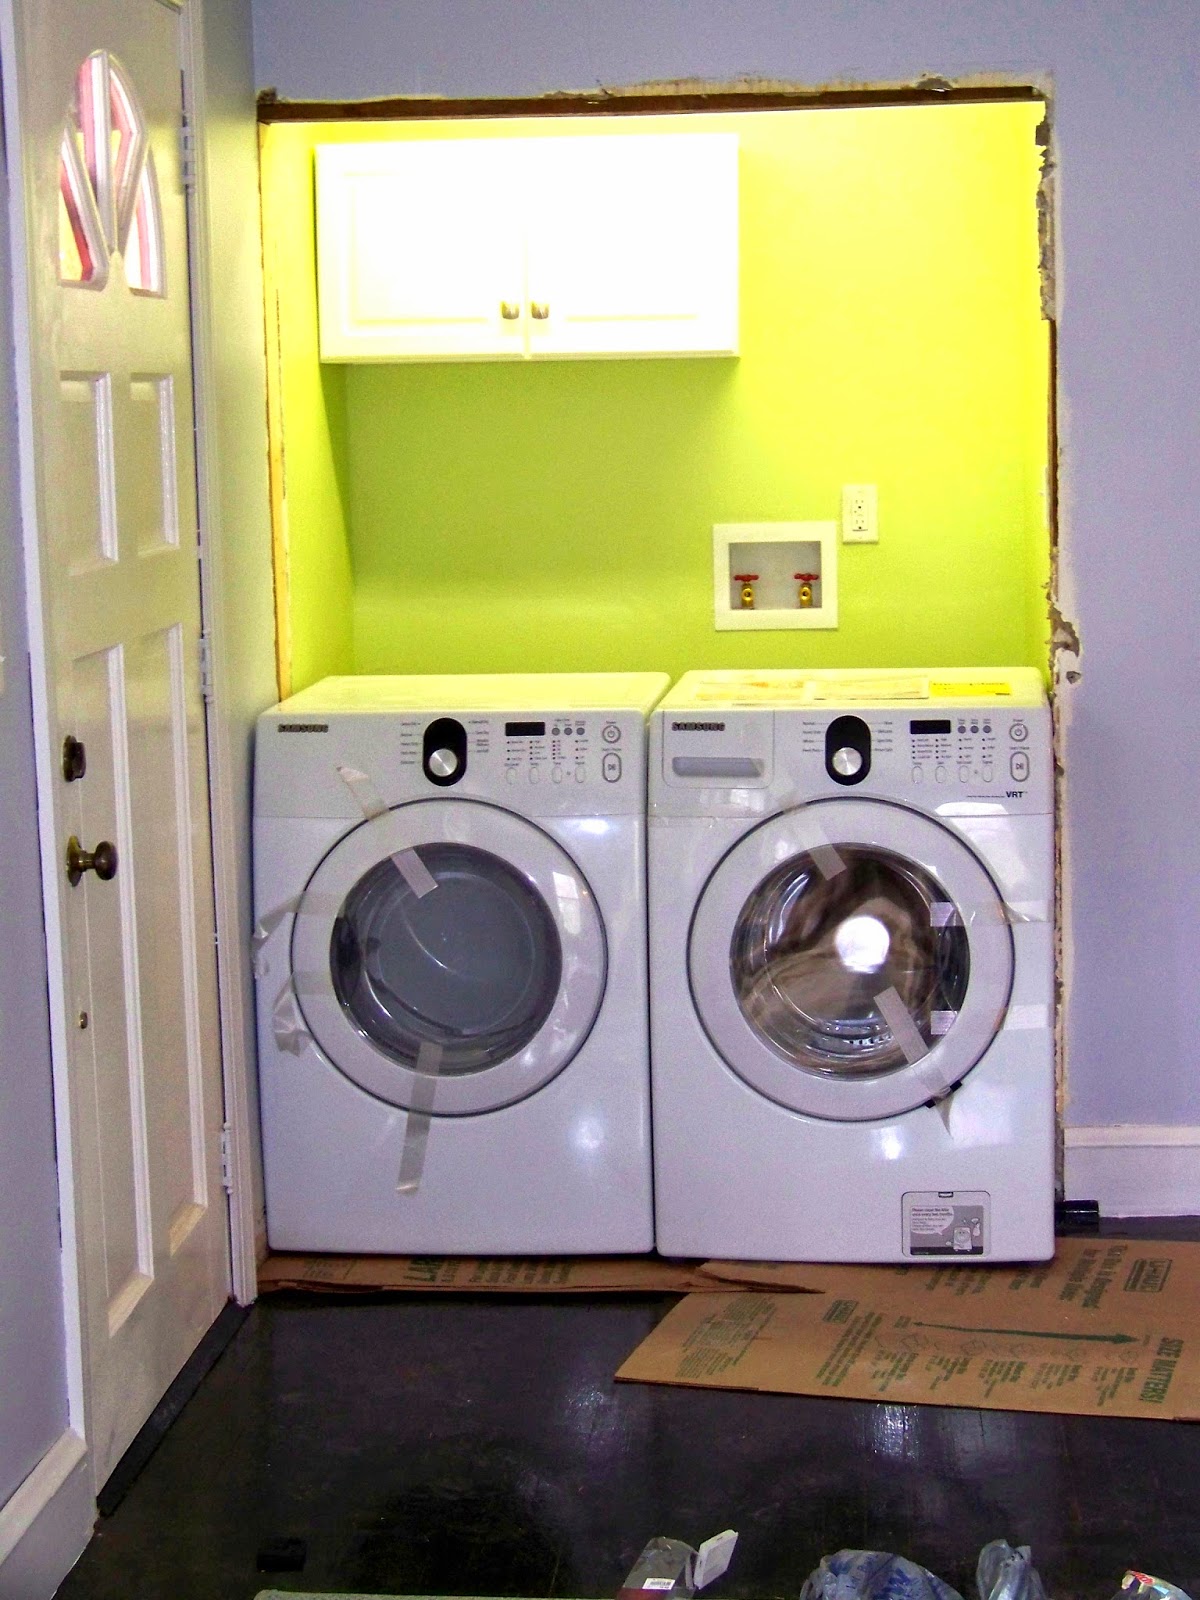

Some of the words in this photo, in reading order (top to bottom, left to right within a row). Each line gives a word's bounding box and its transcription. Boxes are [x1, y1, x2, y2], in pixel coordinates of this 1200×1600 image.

[278, 723, 329, 733] SAMSUNG
[672, 722, 726, 732] SAMSUNG
[1005, 791, 1024, 799] VRT
[1156, 1337, 1184, 1358] SIZE
[1139, 1358, 1177, 1404] MATTERS!
